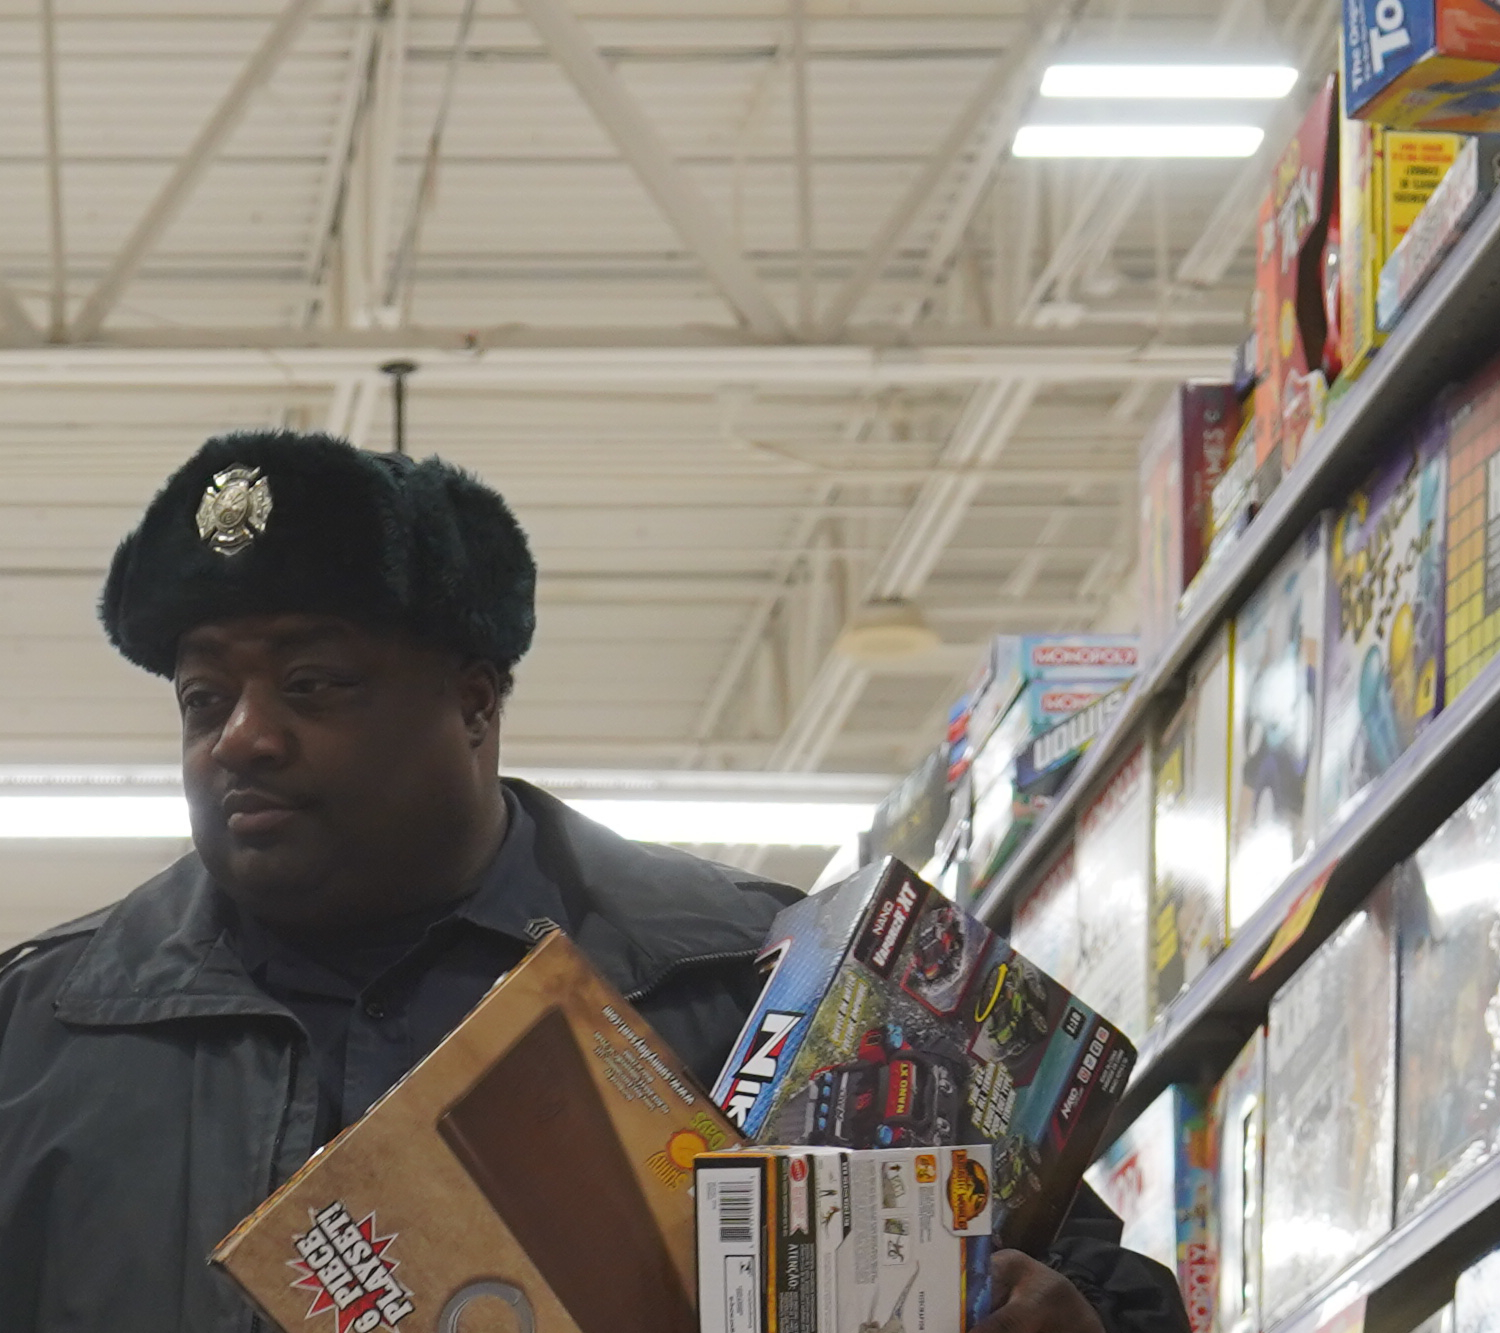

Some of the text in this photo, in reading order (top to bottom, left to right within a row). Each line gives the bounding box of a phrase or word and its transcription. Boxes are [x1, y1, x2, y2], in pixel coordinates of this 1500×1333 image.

[1033, 646, 1137, 666] MONOPOLY
[870, 900, 897, 936] NANO
[895, 1087, 913, 1113] NANO
[689, 1109, 728, 1150] Days
[645, 1147, 688, 1193] Sunny
[292, 1226, 368, 1310] PIECE
[310, 1199, 419, 1326] PLAYSET!
[787, 1244, 799, 1292] ATENÇÃO:
